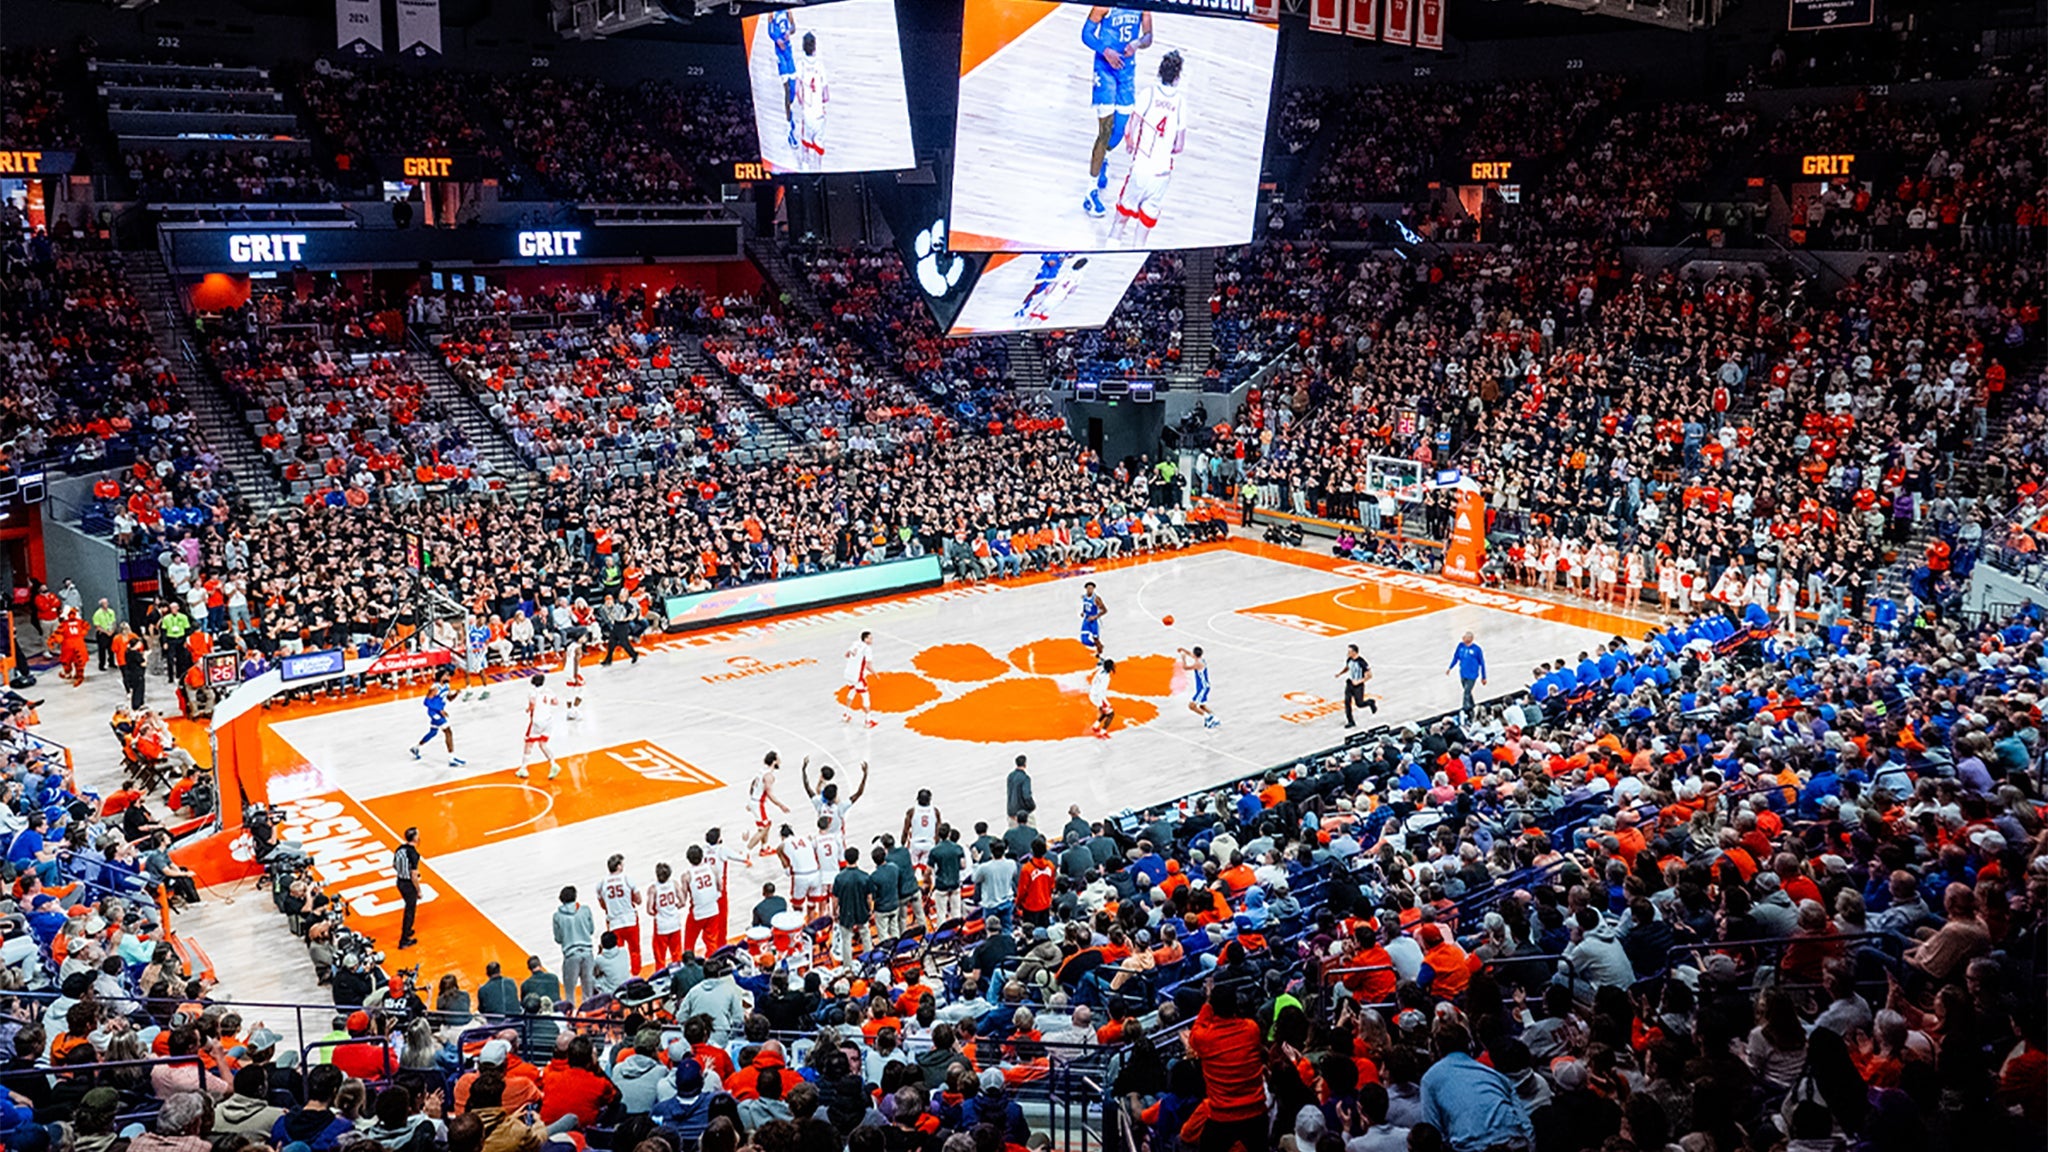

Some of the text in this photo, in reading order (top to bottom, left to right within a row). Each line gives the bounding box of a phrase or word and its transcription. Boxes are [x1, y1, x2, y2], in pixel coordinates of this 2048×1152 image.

[1119, 25, 1133, 42] 15
[157, 36, 180, 48] 232
[1155, 115, 1168, 138] 4
[0, 151, 42, 173] RIT
[403, 157, 453, 177] GRIT
[1802, 154, 1855, 175] GRIT
[1471, 161, 1512, 180] GRIT
[229, 234, 306, 263] GRIT
[518, 231, 581, 256] GRIT
[1399, 418, 1416, 434] 26
[212, 666, 232, 681] 26
[605, 747, 700, 784] ACC
[921, 814, 930, 828] 6
[791, 838, 807, 850] 14
[824, 843, 832, 857] 3
[695, 874, 713, 890] 32
[607, 884, 625, 899] 35
[659, 891, 675, 907] 20
